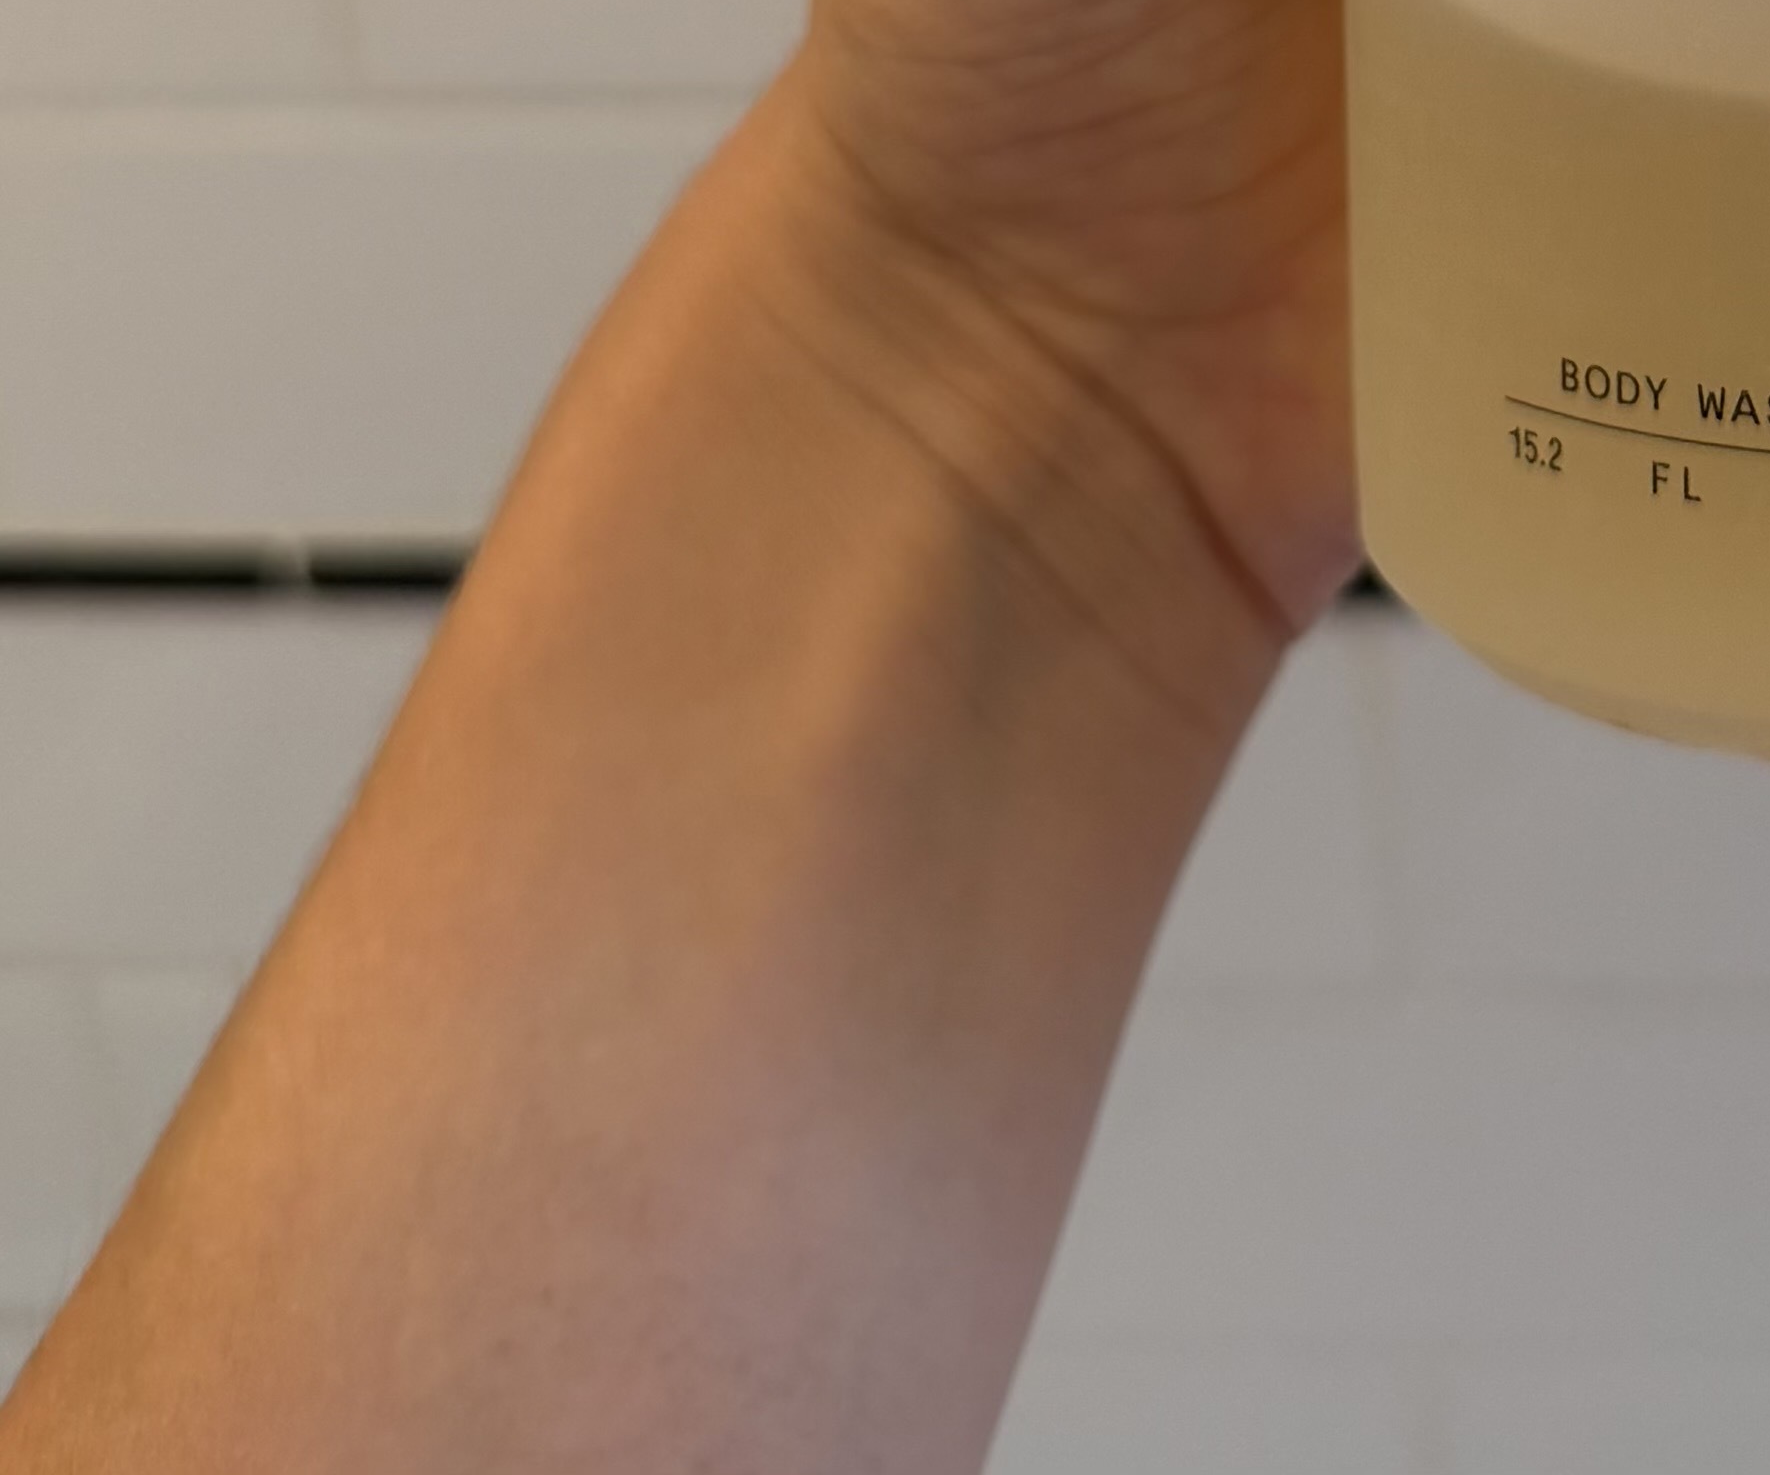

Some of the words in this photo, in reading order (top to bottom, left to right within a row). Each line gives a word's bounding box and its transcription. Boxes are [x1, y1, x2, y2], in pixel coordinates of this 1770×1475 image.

[1560, 356, 1668, 412] BODY
[1508, 426, 1564, 474] 15.2
[1651, 460, 1703, 504] FL
